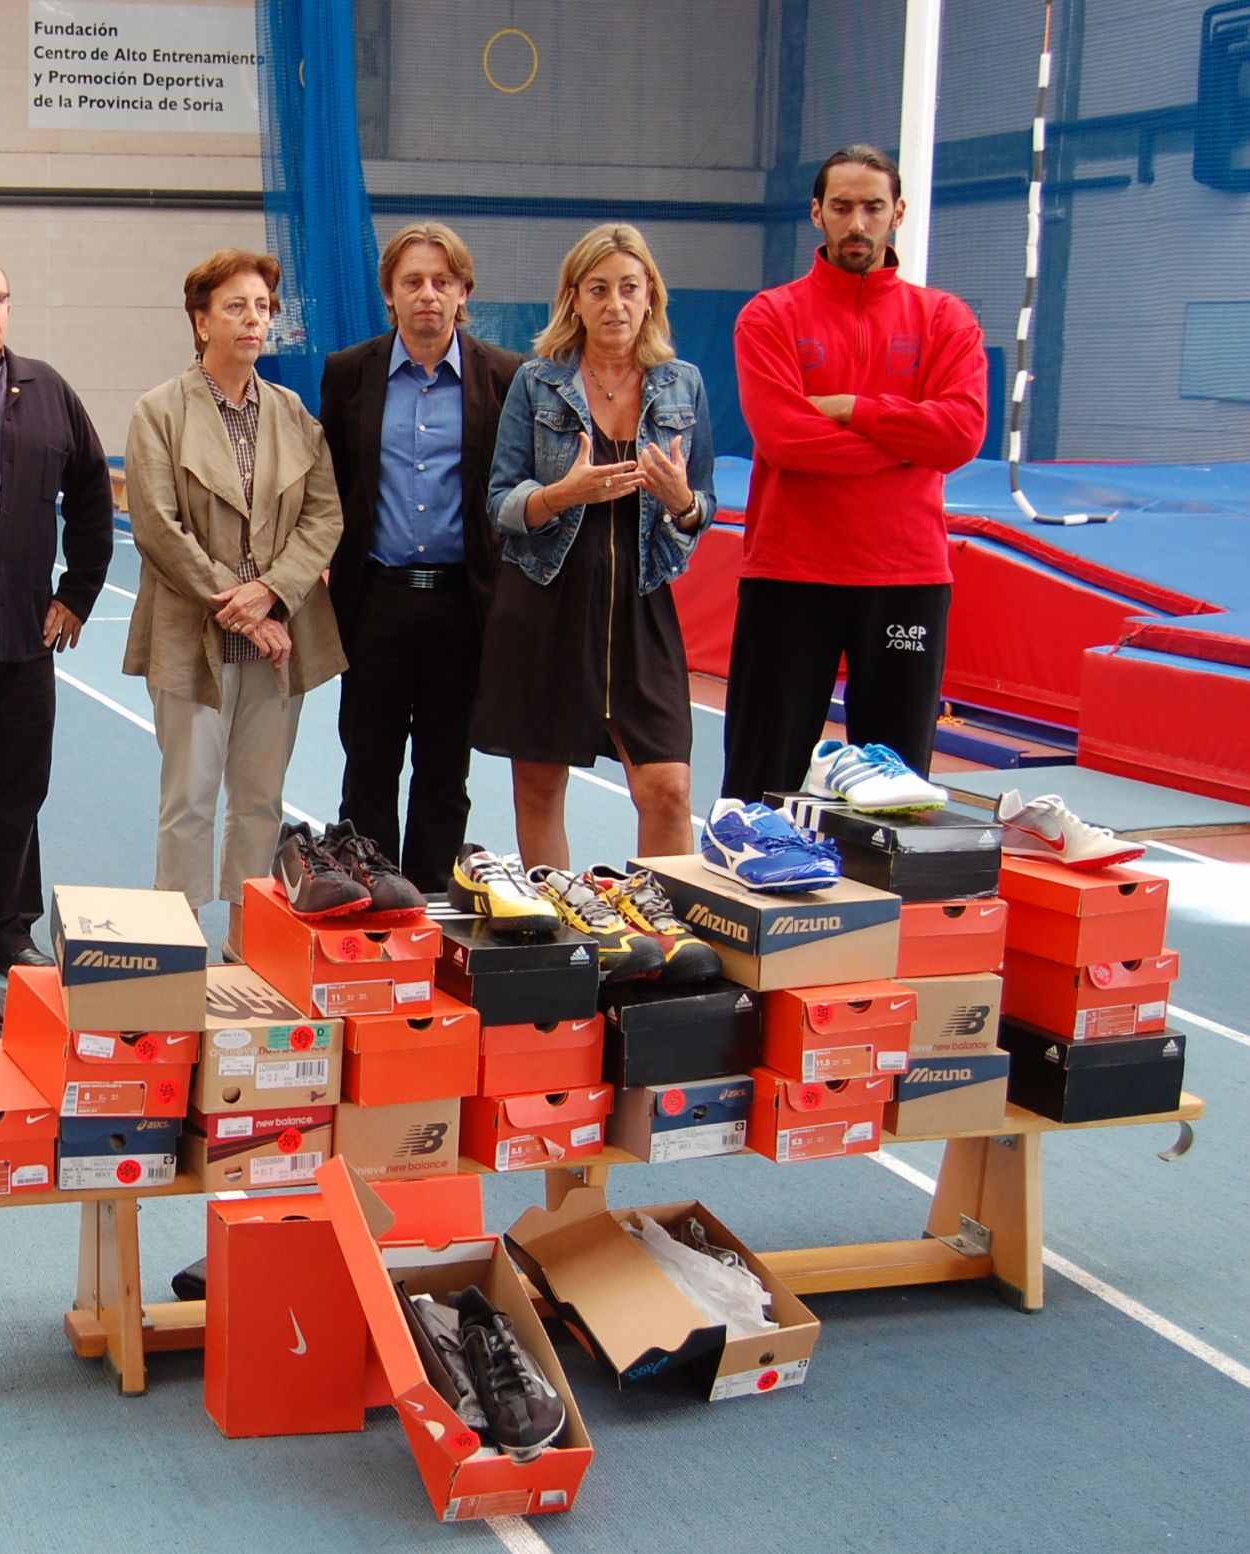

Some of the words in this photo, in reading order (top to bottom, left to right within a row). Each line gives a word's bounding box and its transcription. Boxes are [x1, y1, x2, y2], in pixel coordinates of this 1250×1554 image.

[34, 21, 119, 37] Fundación
[33, 46, 87, 60] Centro
[90, 48, 109, 61] de
[114, 48, 148, 62] Alto
[152, 49, 265, 66] Entrenamiento
[33, 72, 42, 87] y
[48, 70, 137, 87] Promoción
[143, 73, 224, 90] Deportiva
[33, 94, 54, 108] de
[59, 95, 72, 108] la
[78, 95, 153, 111] Provincia
[158, 98, 178, 111] de
[183, 98, 224, 112] Soria
[685, 903, 749, 943] MIZUNO
[766, 916, 841, 936] MIZUNO
[71, 949, 159, 971] MIZUNO
[904, 1067, 972, 1084] MIZUNO
[256, 1120, 275, 1129] new
[275, 1116, 313, 1127] balance
[407, 1160, 448, 1171] balance
